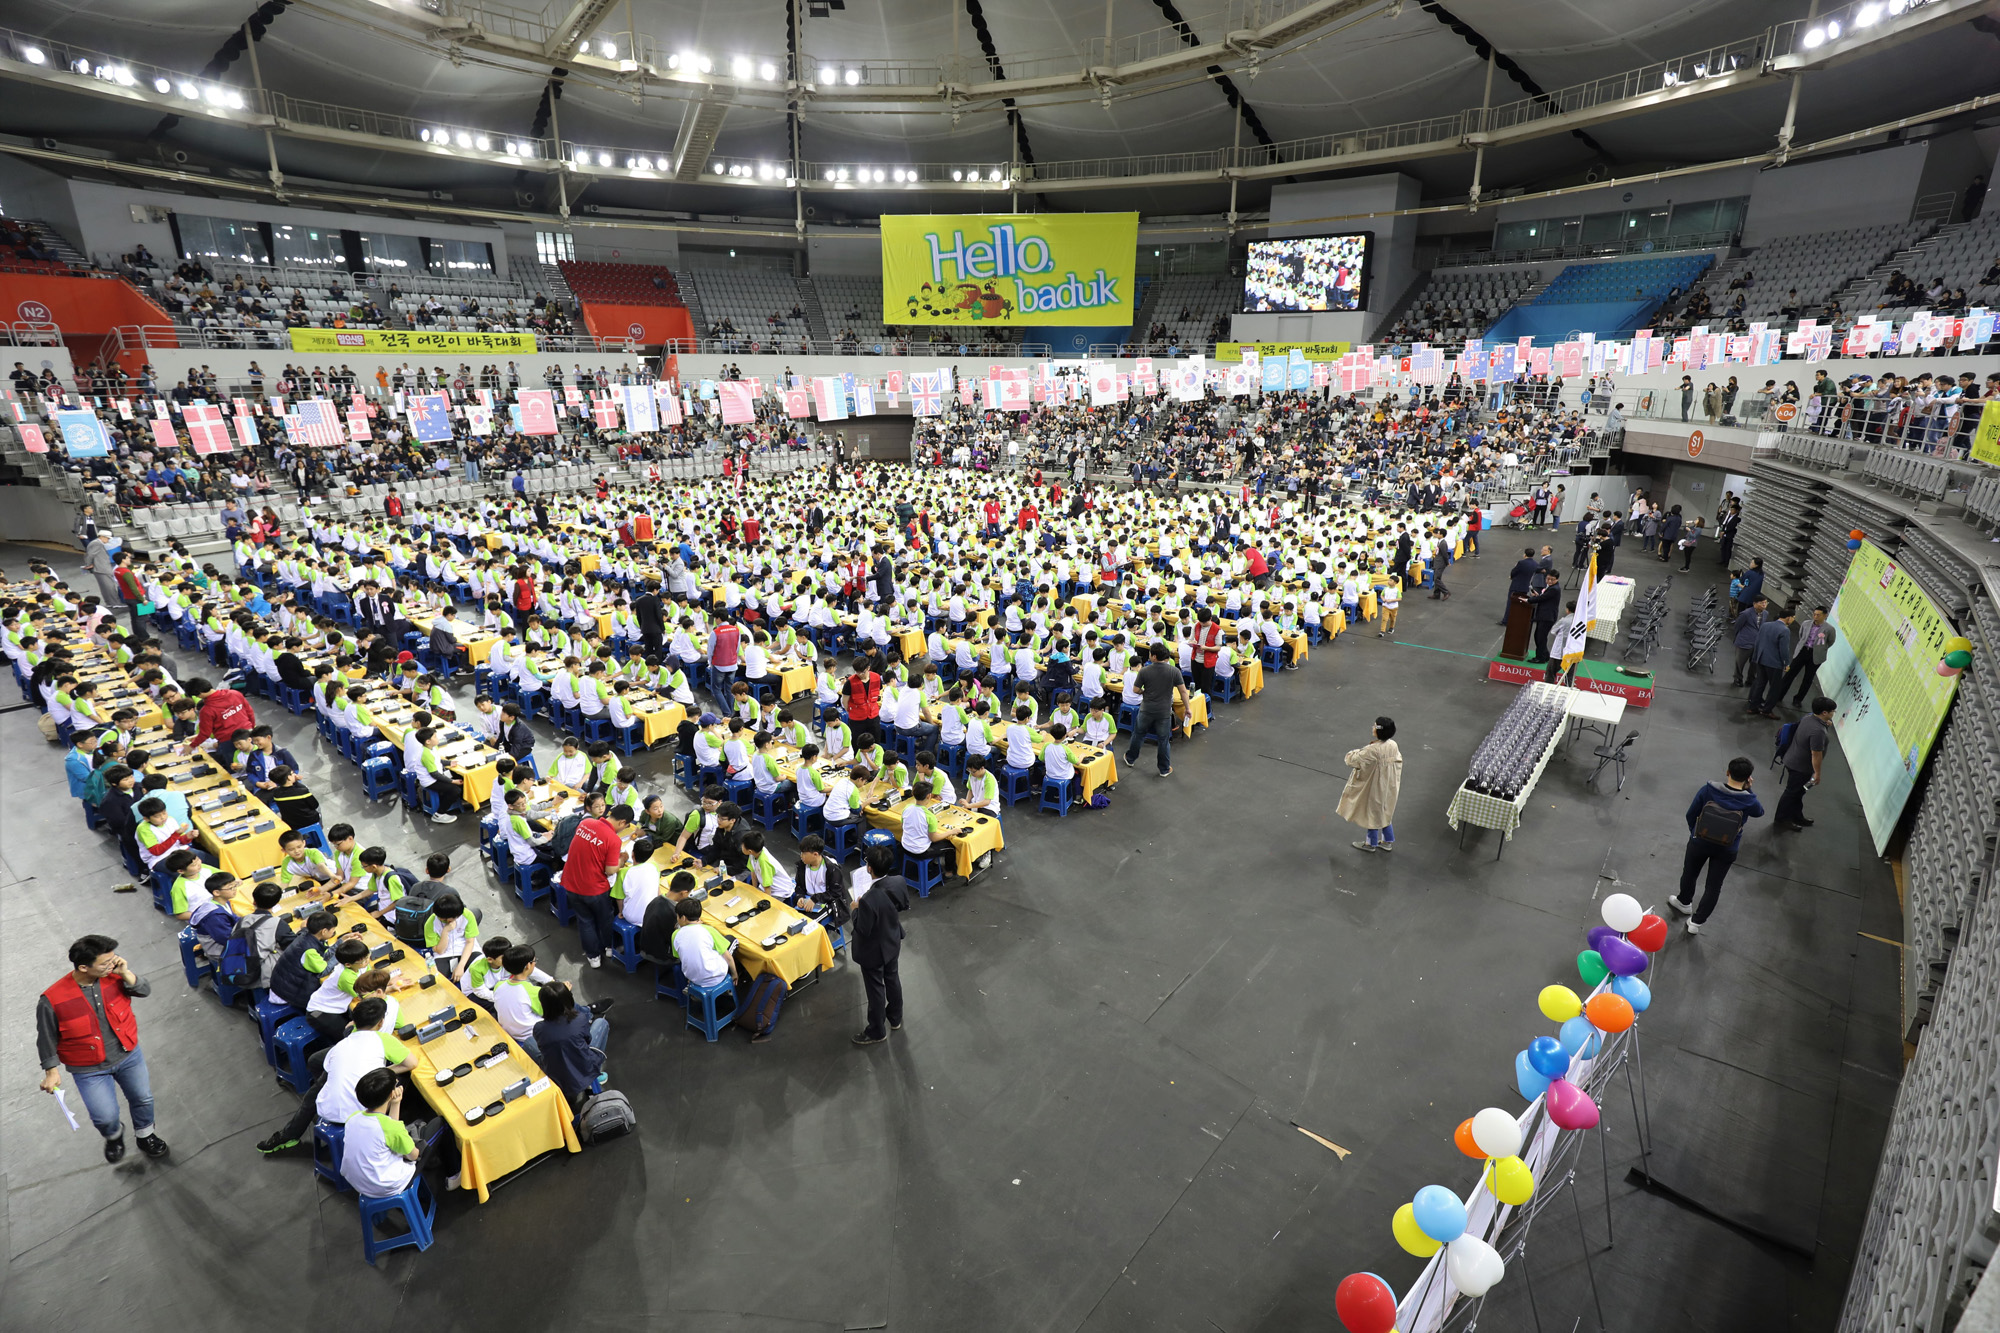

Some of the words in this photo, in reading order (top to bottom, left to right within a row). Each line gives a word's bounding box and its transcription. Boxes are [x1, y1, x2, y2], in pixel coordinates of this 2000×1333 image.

[924, 223, 1055, 283] Hello,
[1013, 270, 1121, 314] baduk
[24, 306, 46, 318] N2
[631, 327, 642, 335] N3
[380, 333, 410, 348] 전국
[417, 335, 461, 348] 어린이
[466, 334, 522, 349] 바둑대회
[1261, 344, 1276, 355] 전국
[1305, 344, 1338, 355] 바둑대회
[1783, 409, 1794, 417] 04
[1691, 435, 1701, 448] S1
[1499, 664, 1533, 678] BADUK
[1589, 681, 1627, 695] BADUK
[576, 828, 591, 841] Club
[590, 837, 604, 846] A7
